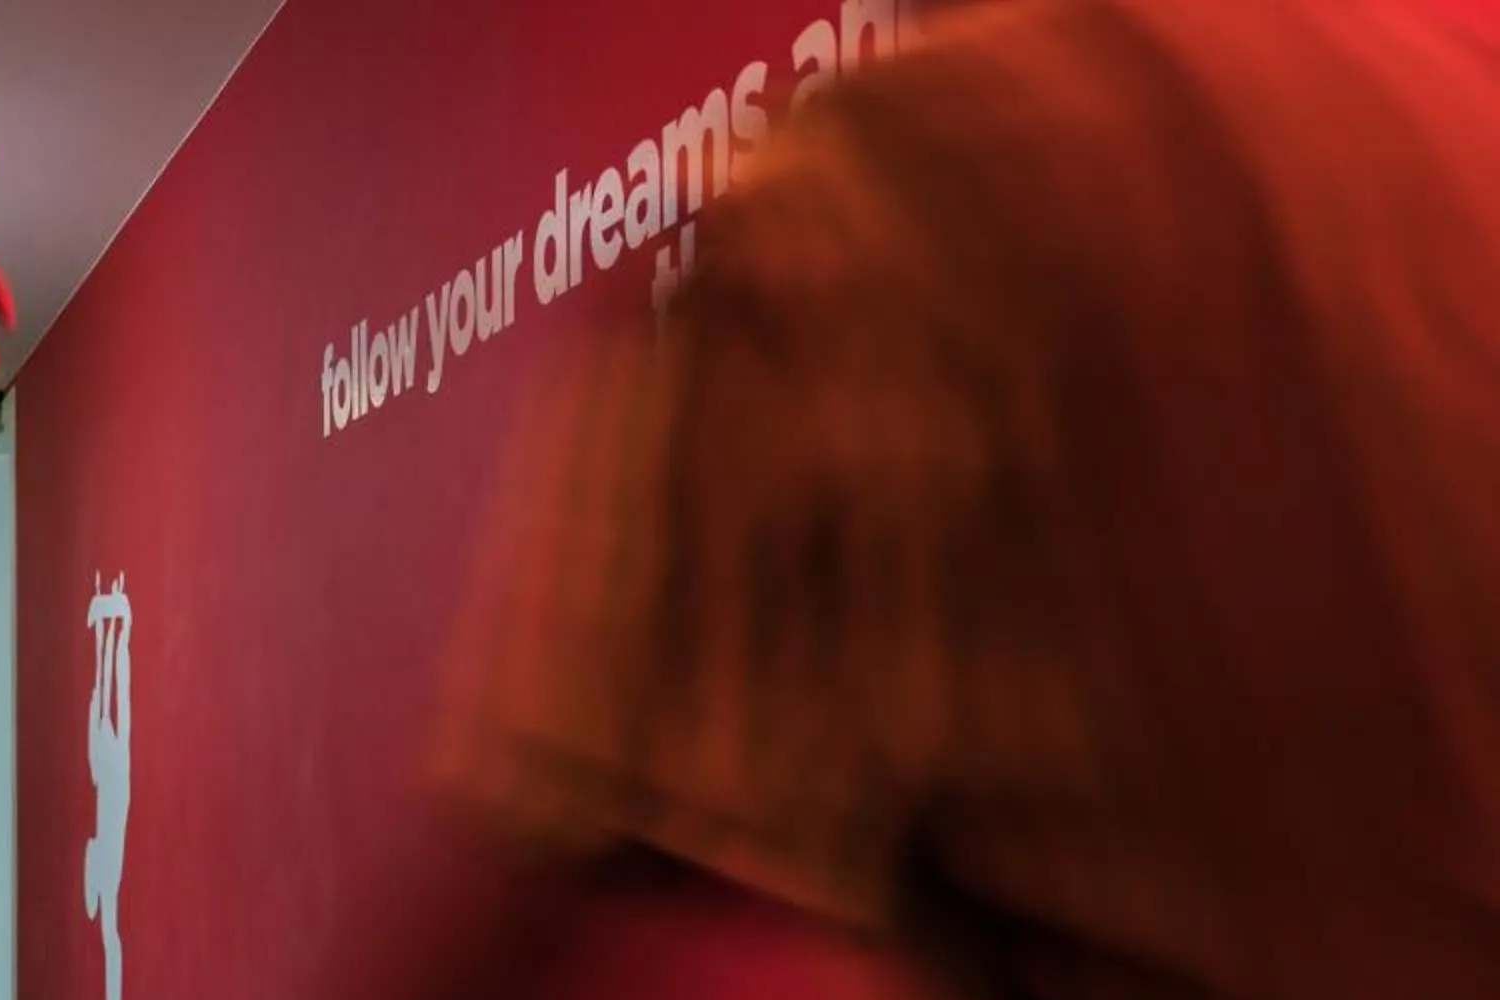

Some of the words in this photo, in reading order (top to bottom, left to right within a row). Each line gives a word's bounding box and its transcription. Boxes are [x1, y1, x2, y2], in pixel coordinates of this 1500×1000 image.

[321, 305, 419, 438] follow
[425, 229, 523, 394] your
[533, 60, 769, 305] dreams
